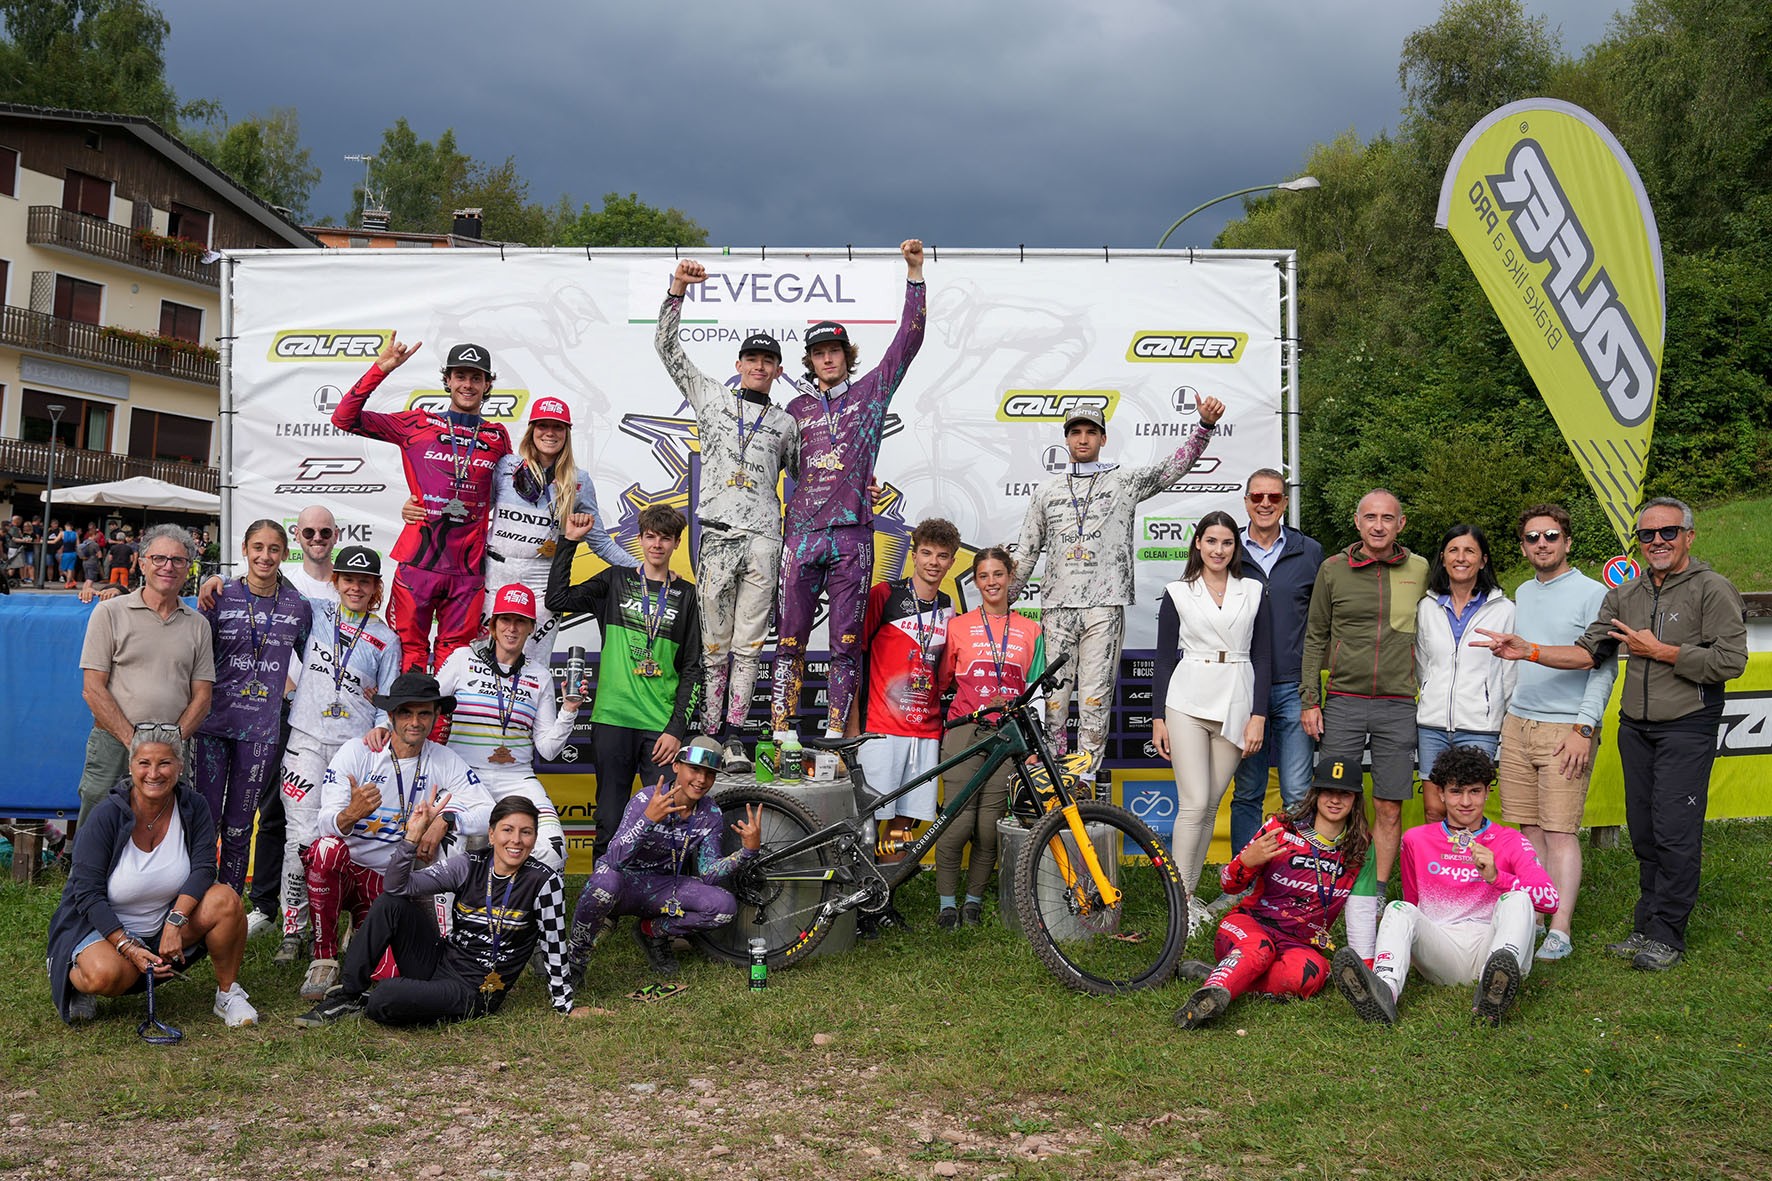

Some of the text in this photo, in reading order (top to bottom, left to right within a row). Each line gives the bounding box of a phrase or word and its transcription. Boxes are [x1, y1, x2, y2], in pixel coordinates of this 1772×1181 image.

[678, 328, 741, 342] COPPA
[276, 335, 383, 357] GALFER
[1134, 335, 1239, 358] GALFER
[473, 458, 496, 470] CRU
[274, 484, 387, 494] PROGRIP
[1162, 483, 1242, 493] OGRIP
[498, 508, 561, 530] HONDA
[495, 529, 527, 542] SANTA
[1144, 550, 1168, 559] CLEAN
[1174, 550, 1189, 559] LUB
[1133, 668, 1154, 677] FOCUS
[773, 659, 793, 715] TRENTINO
[912, 814, 947, 854] FORBIDDEN
[568, 838, 594, 848] ITA
[1150, 840, 1178, 883] MAXXIS
[1271, 872, 1318, 893] SANTA
